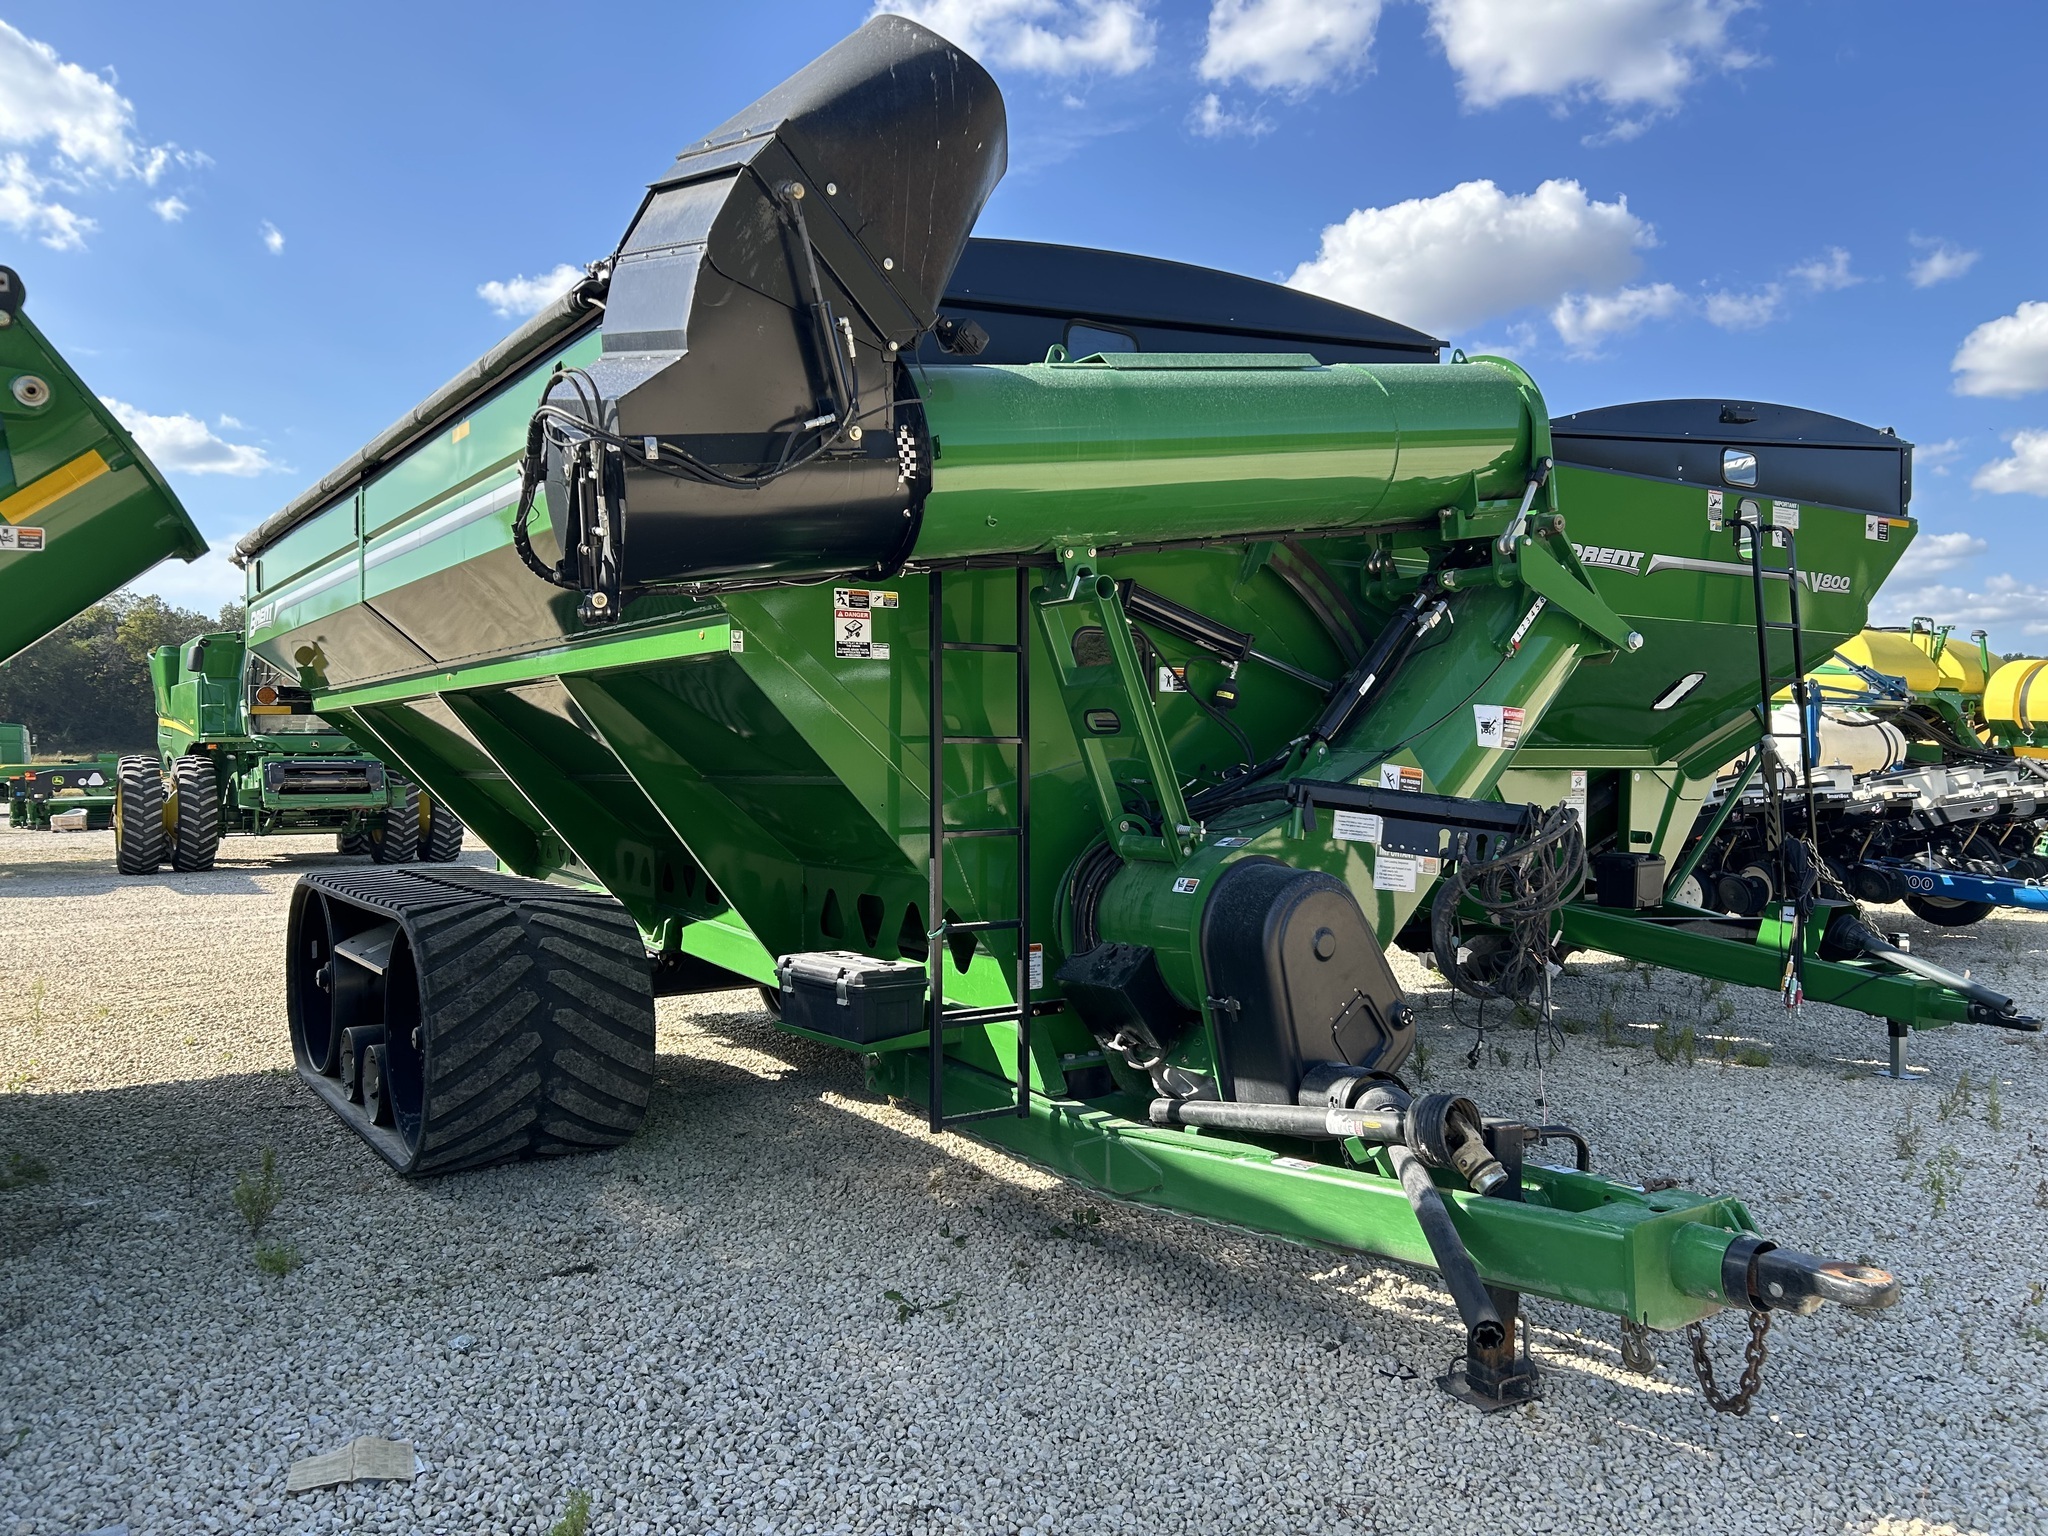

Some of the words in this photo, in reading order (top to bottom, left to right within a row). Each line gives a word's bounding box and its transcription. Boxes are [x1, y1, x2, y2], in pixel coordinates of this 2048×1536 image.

[1774, 500, 1798, 509] IMPORTANT
[1810, 571, 1851, 593] V800
[249, 602, 274, 638] BRENT
